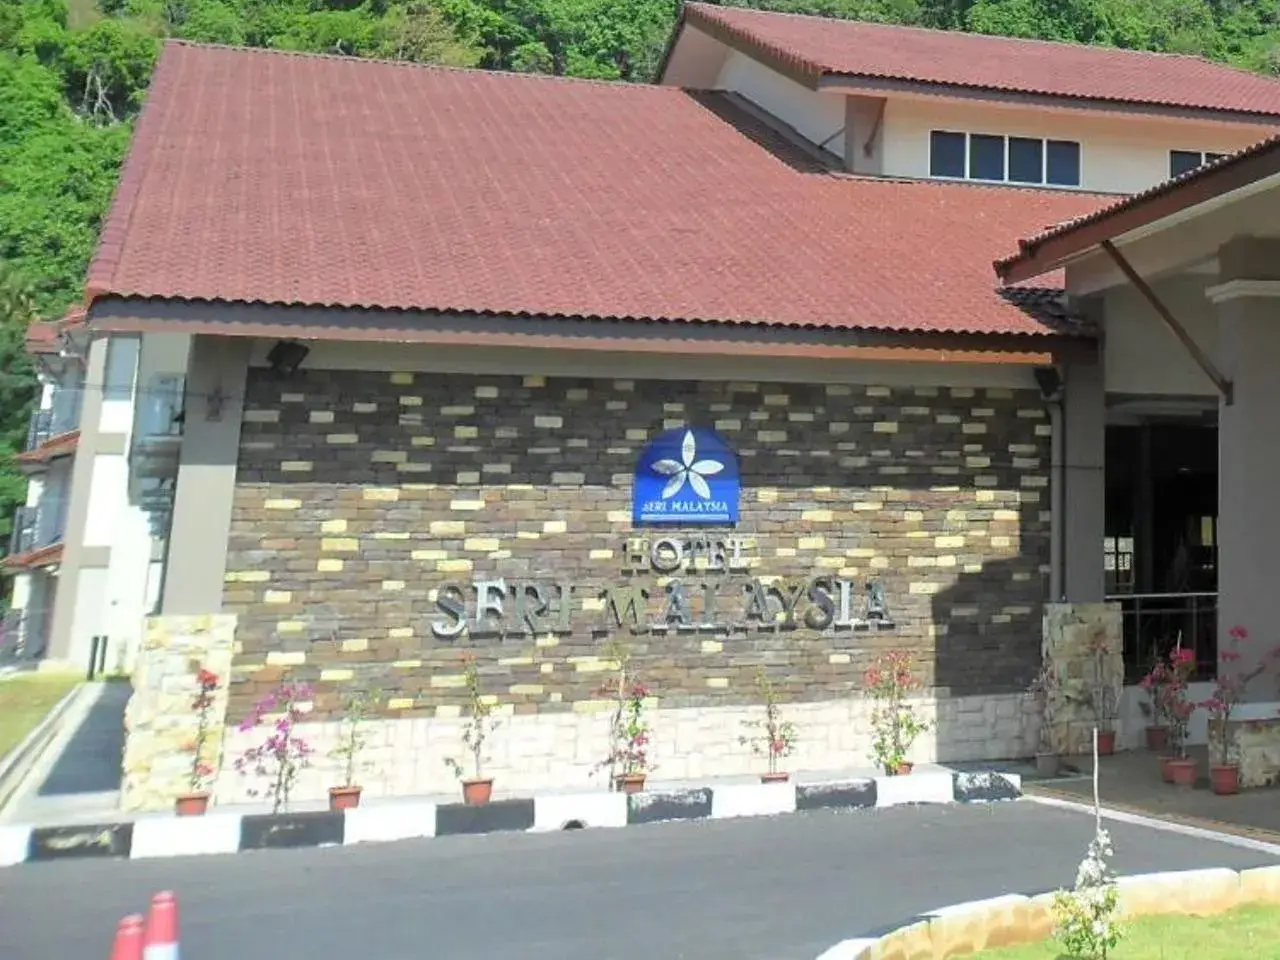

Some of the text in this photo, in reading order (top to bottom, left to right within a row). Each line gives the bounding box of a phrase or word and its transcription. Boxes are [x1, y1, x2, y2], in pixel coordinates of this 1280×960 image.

[671, 500, 728, 512] MALAYSIA
[621, 537, 752, 575] HOTEL
[431, 575, 897, 639] SERI MALAYSIA
